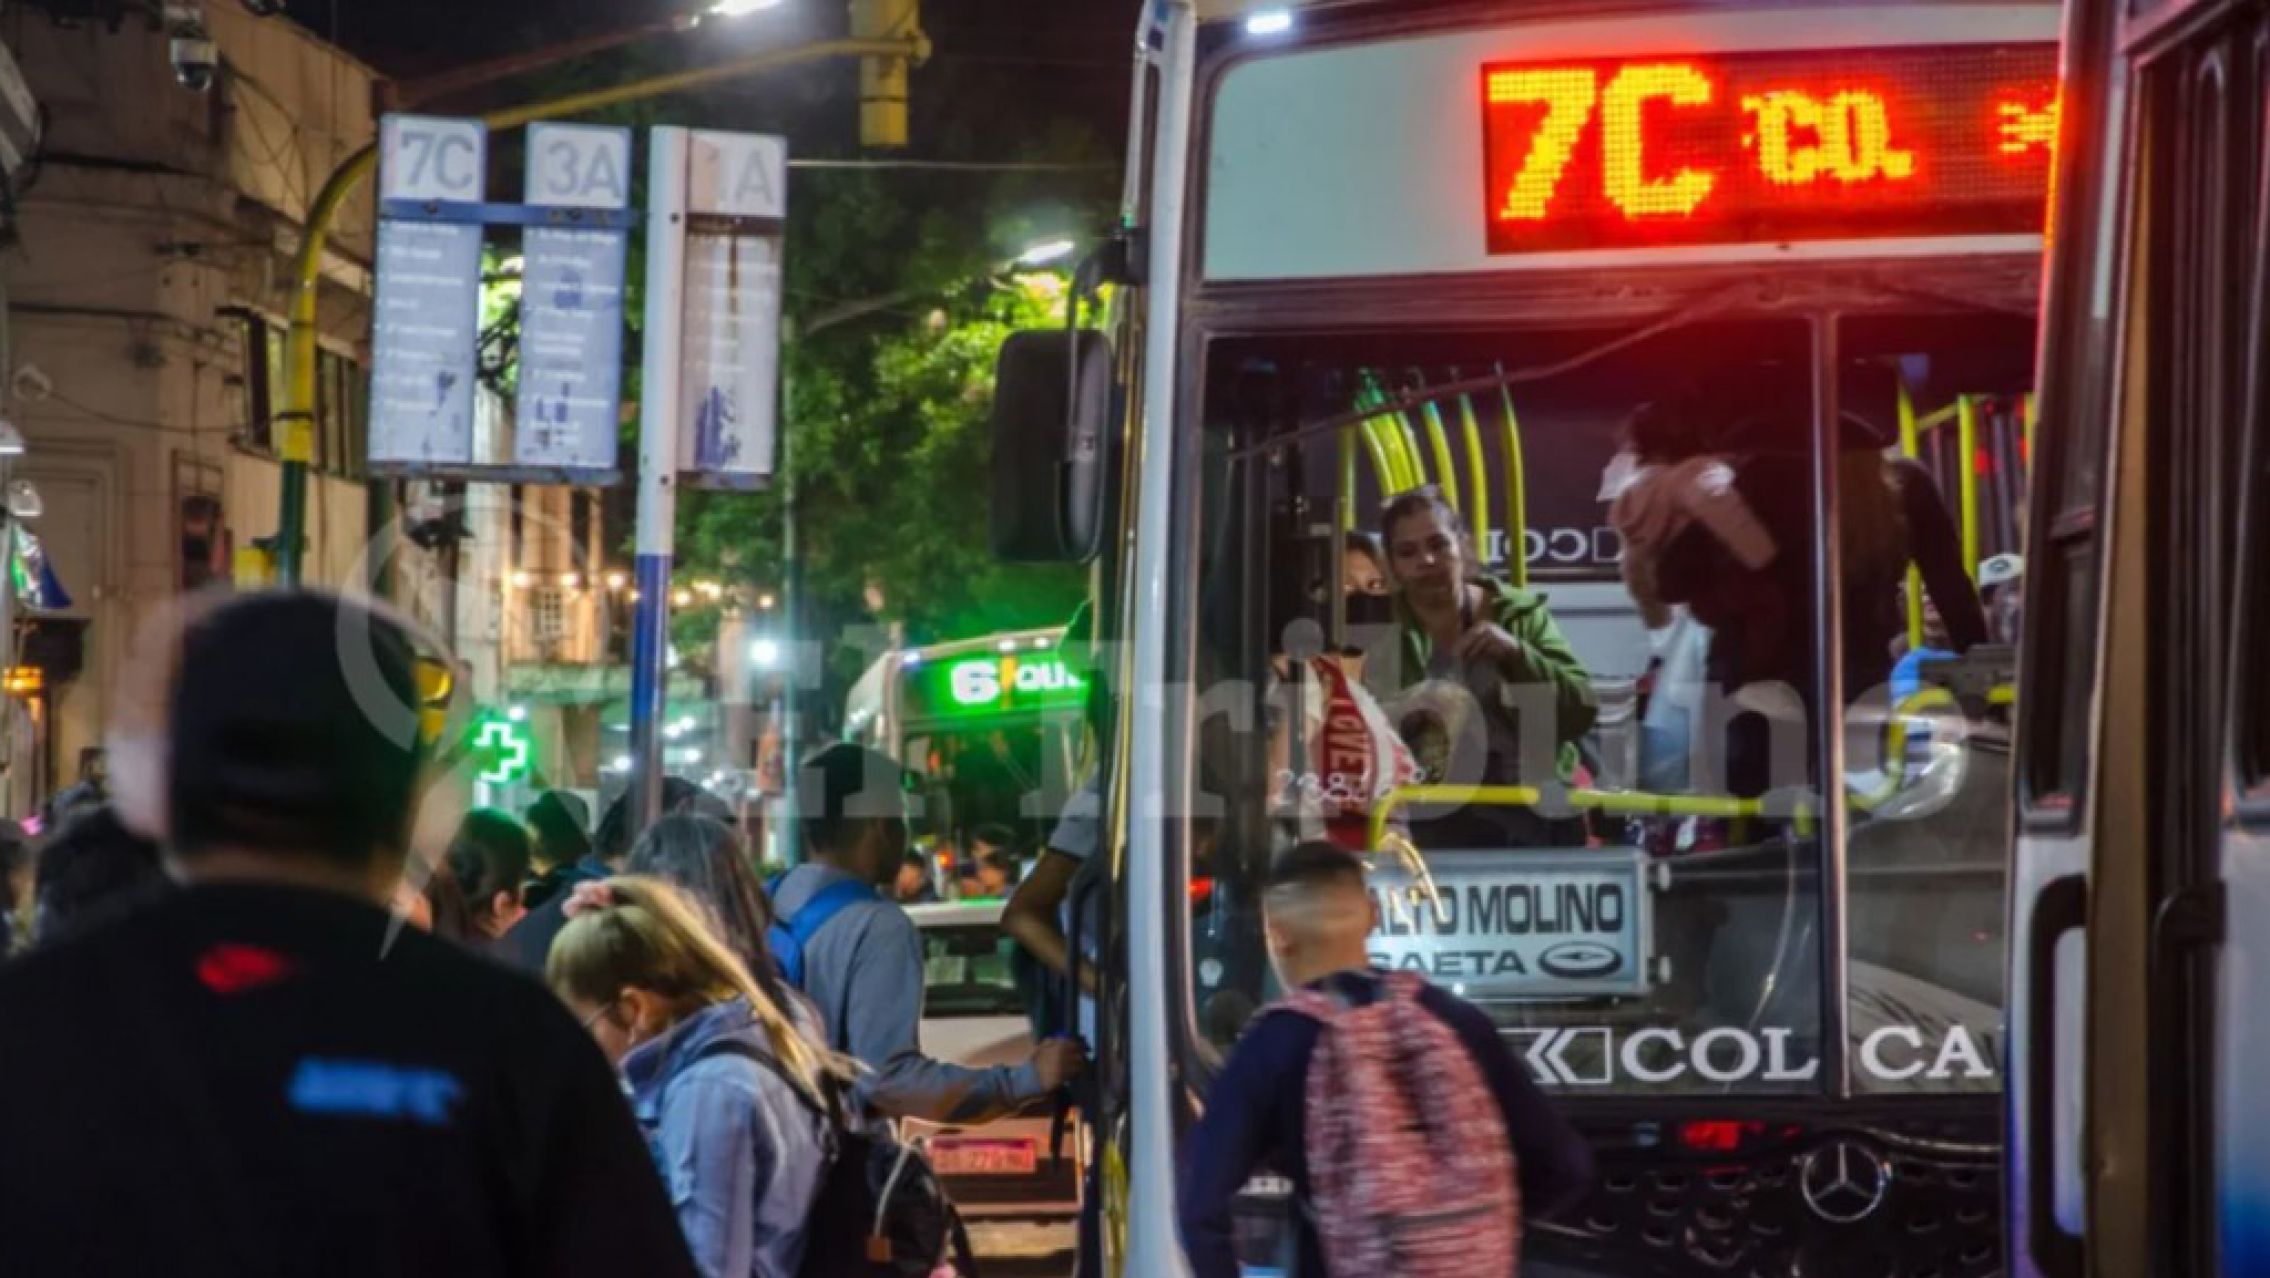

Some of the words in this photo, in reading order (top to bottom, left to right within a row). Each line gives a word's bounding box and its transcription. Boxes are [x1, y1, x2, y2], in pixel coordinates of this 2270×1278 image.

[401, 130, 474, 190] 7C
[549, 140, 622, 198] 3A
[1489, 64, 1714, 220] 7C
[951, 661, 1000, 704] 6
[1468, 882, 1623, 934] MOLINO
